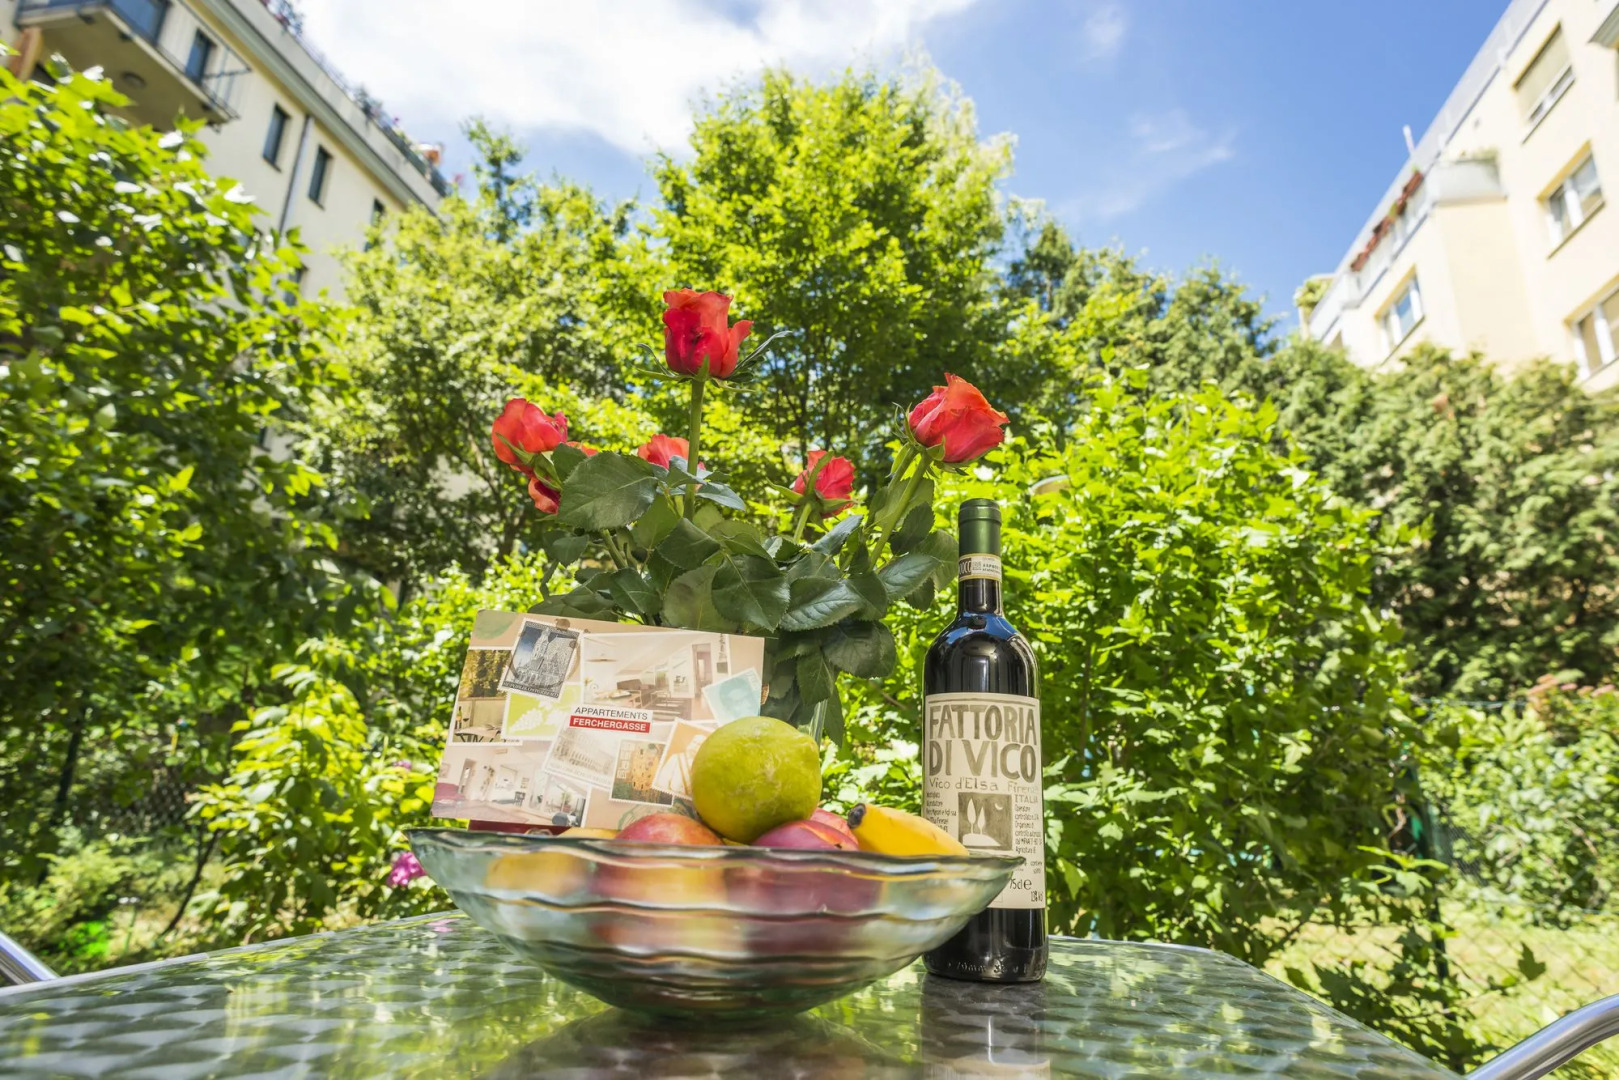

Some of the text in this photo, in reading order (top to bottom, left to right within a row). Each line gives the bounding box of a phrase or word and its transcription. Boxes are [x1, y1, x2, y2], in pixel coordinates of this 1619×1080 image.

[574, 706, 648, 721] APPARTEMENTS
[572, 717, 647, 732] FERCHERGASSE
[929, 704, 1037, 746] FATTORIA
[928, 739, 1037, 783] DI VICO
[929, 777, 951, 789] Vico
[955, 777, 999, 791] d'Elsa
